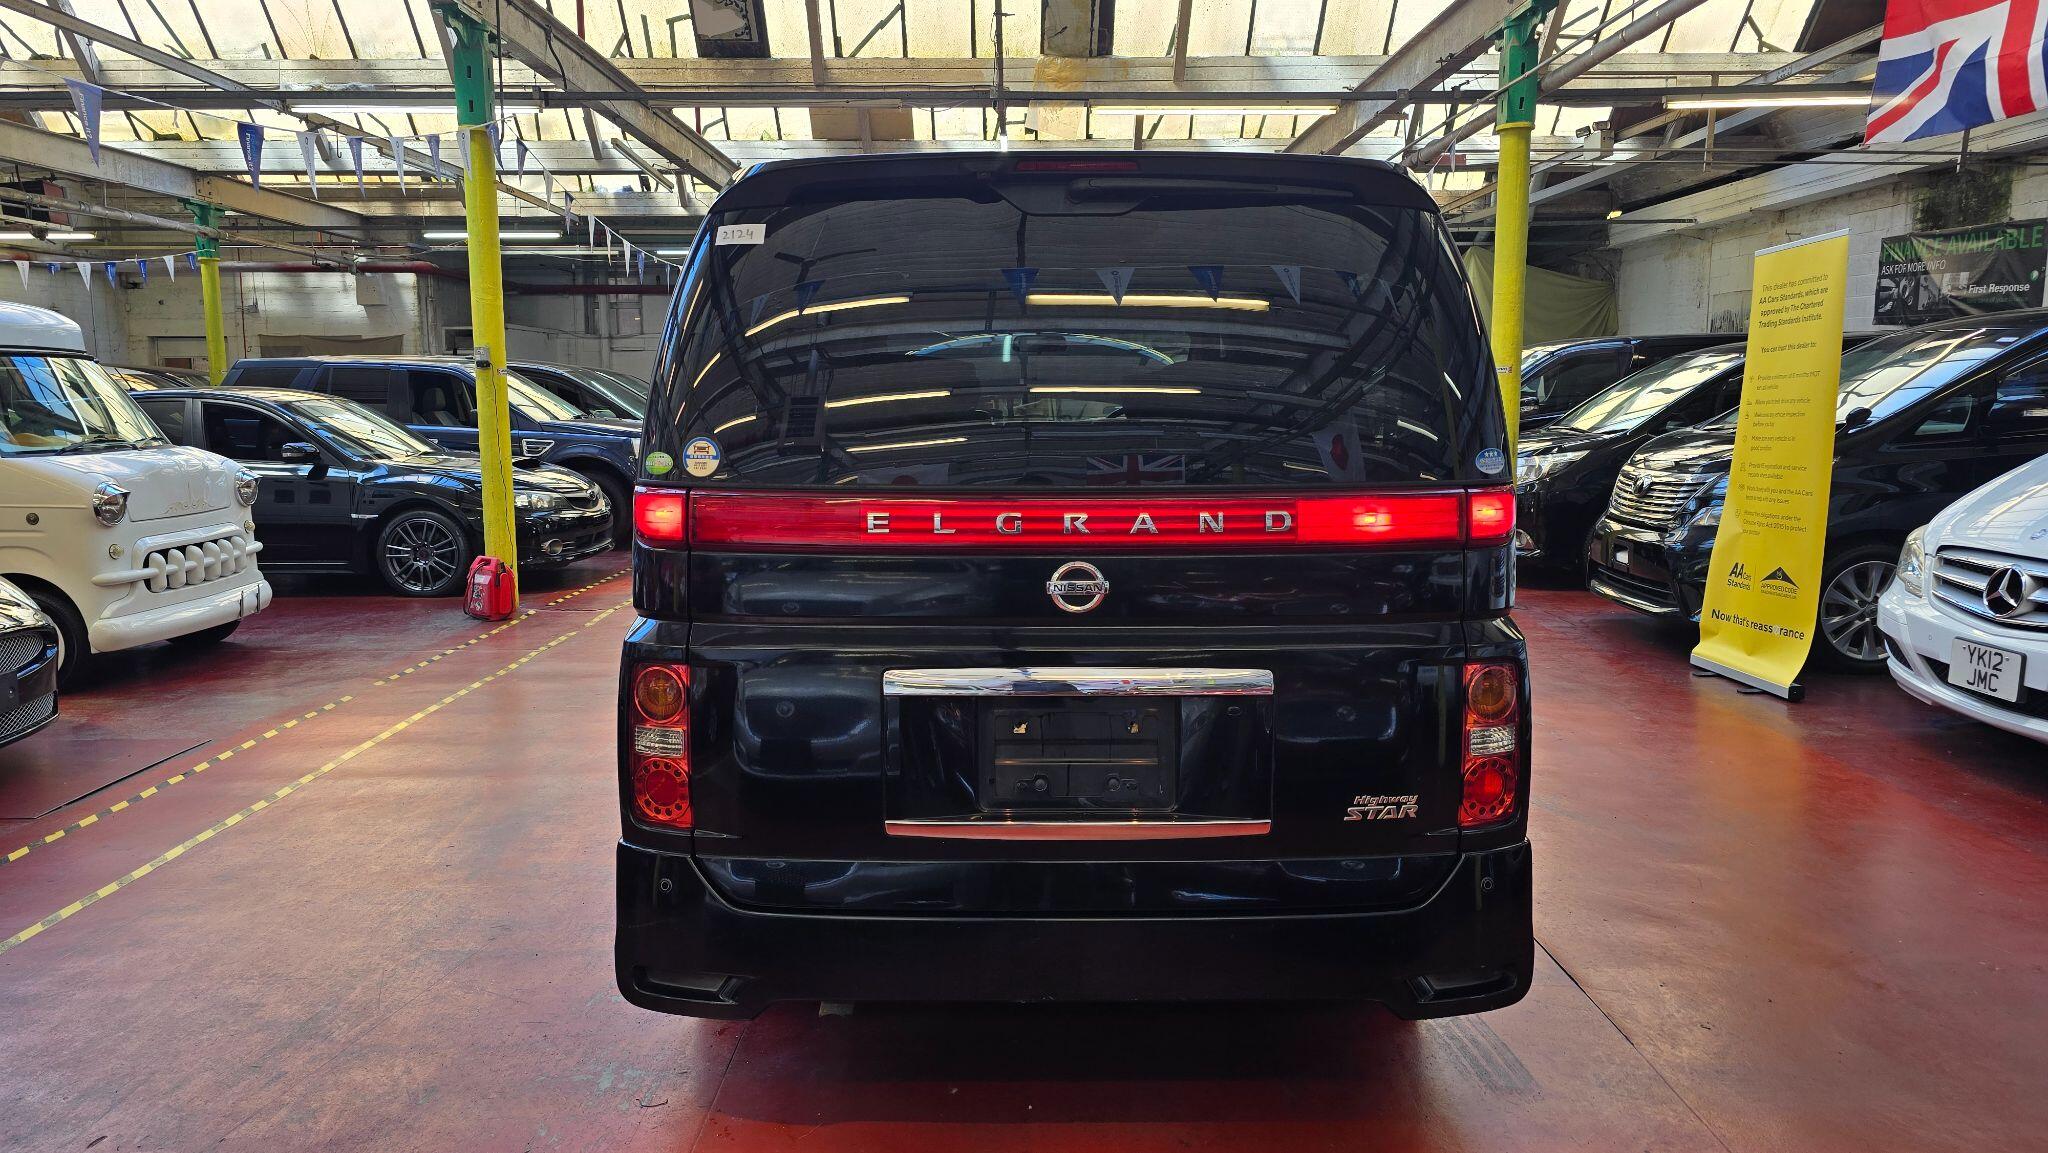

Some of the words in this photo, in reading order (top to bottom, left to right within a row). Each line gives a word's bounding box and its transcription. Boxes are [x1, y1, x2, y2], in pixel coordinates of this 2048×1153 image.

[722, 229, 754, 240] 2124
[1946, 225, 2044, 255] AVAILABLE
[1881, 264, 1894, 276] ASK
[1908, 262, 1926, 273] MORE
[1926, 260, 1946, 272] INFO
[1968, 284, 1987, 294] First
[1988, 284, 2030, 294] Response
[1760, 306, 1784, 317] approved
[1800, 299, 1824, 310] Chartered
[1768, 296, 1780, 304] Cars
[1758, 320, 1778, 328] Trading
[866, 511, 1292, 534] ELGRAND
[1729, 562, 1744, 578] AA
[1053, 584, 1102, 592] NISSAN
[1712, 608, 1732, 622] Now
[1732, 613, 1750, 628] that's
[1968, 644, 2004, 672] YK12
[1966, 668, 1998, 692] JMC
[1354, 794, 1418, 807] Highway
[1344, 804, 1418, 820] STAR
